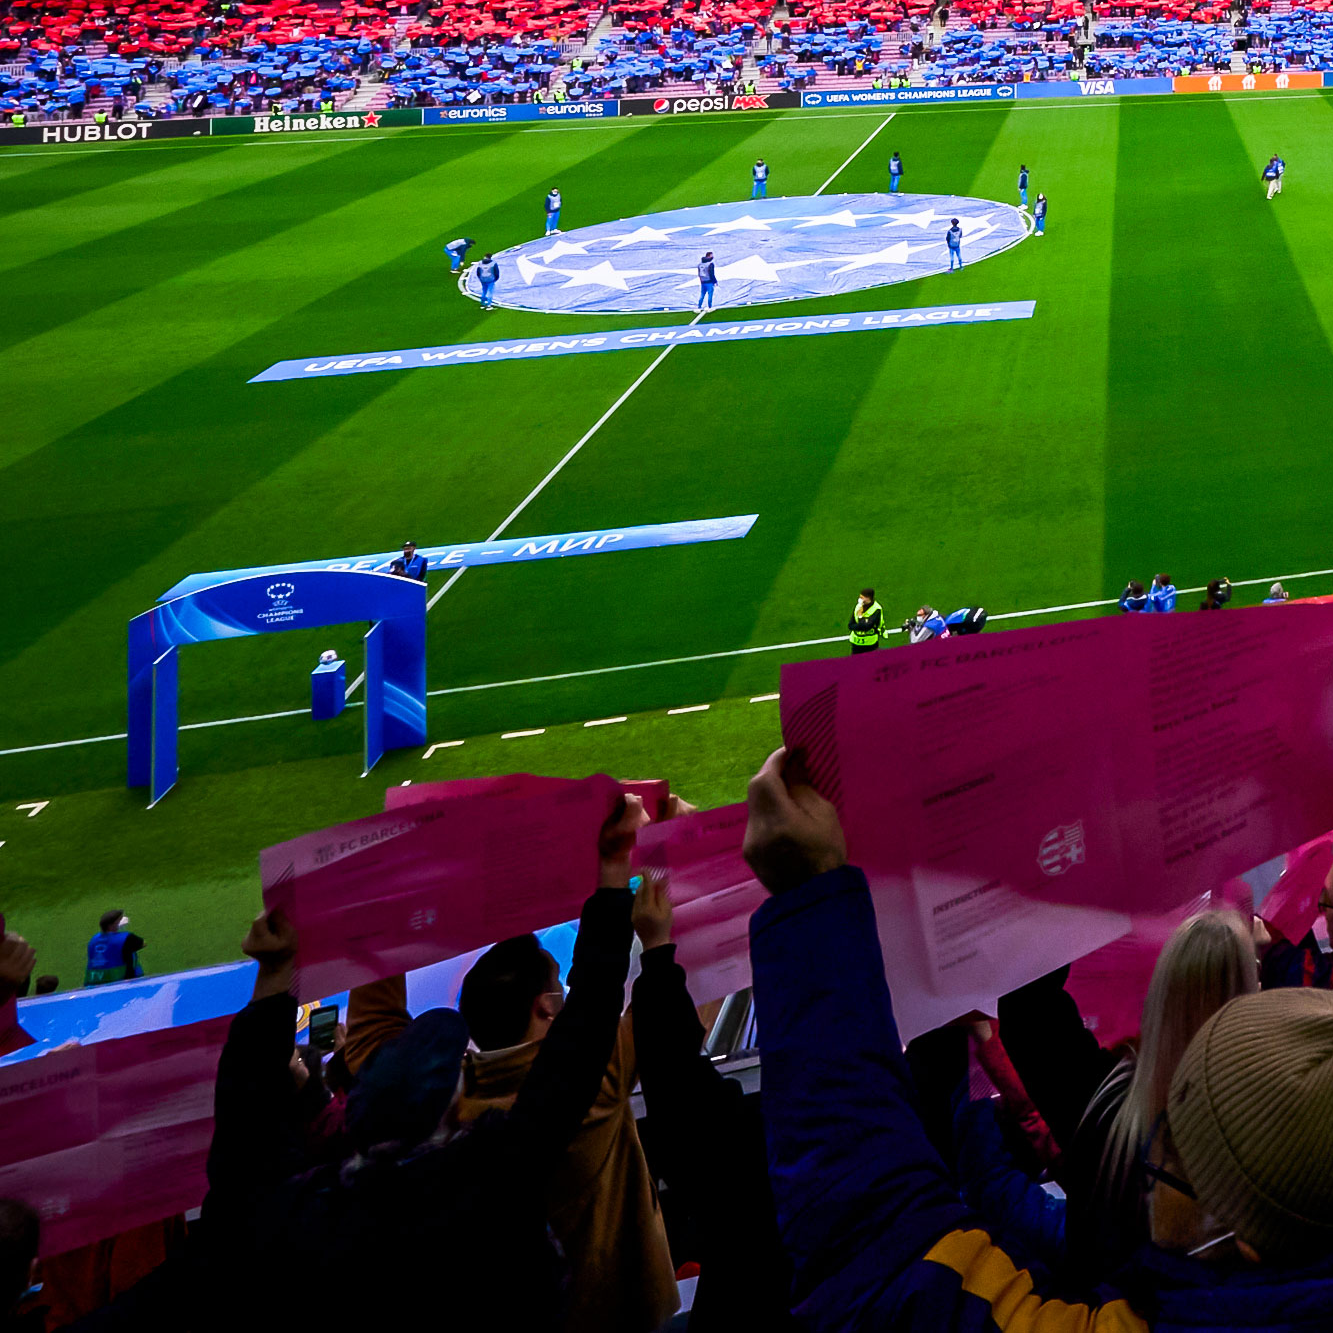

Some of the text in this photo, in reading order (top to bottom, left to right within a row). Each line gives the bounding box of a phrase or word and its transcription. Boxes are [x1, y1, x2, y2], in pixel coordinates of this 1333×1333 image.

[826, 87, 992, 103] UEFA WOMEN'S CHAMPIONS LEAGUE
[1079, 80, 1116, 95] VISA
[546, 102, 604, 116] euronics
[673, 94, 771, 114] pepsi MAX
[448, 105, 507, 120] euronics
[253, 113, 361, 133] Heineken
[42, 122, 153, 143] HUBLOT
[303, 307, 993, 373] UEFA WOMEN'S CHAMPIONS LEAGUE
[512, 533, 625, 557] МИР
[257, 608, 304, 619] CHAMPIONS
[266, 615, 294, 624] LEAGUE
[338, 838, 357, 854] FC
[90, 970, 105, 981] TV
[0, 1067, 81, 1097] ARCELONA
